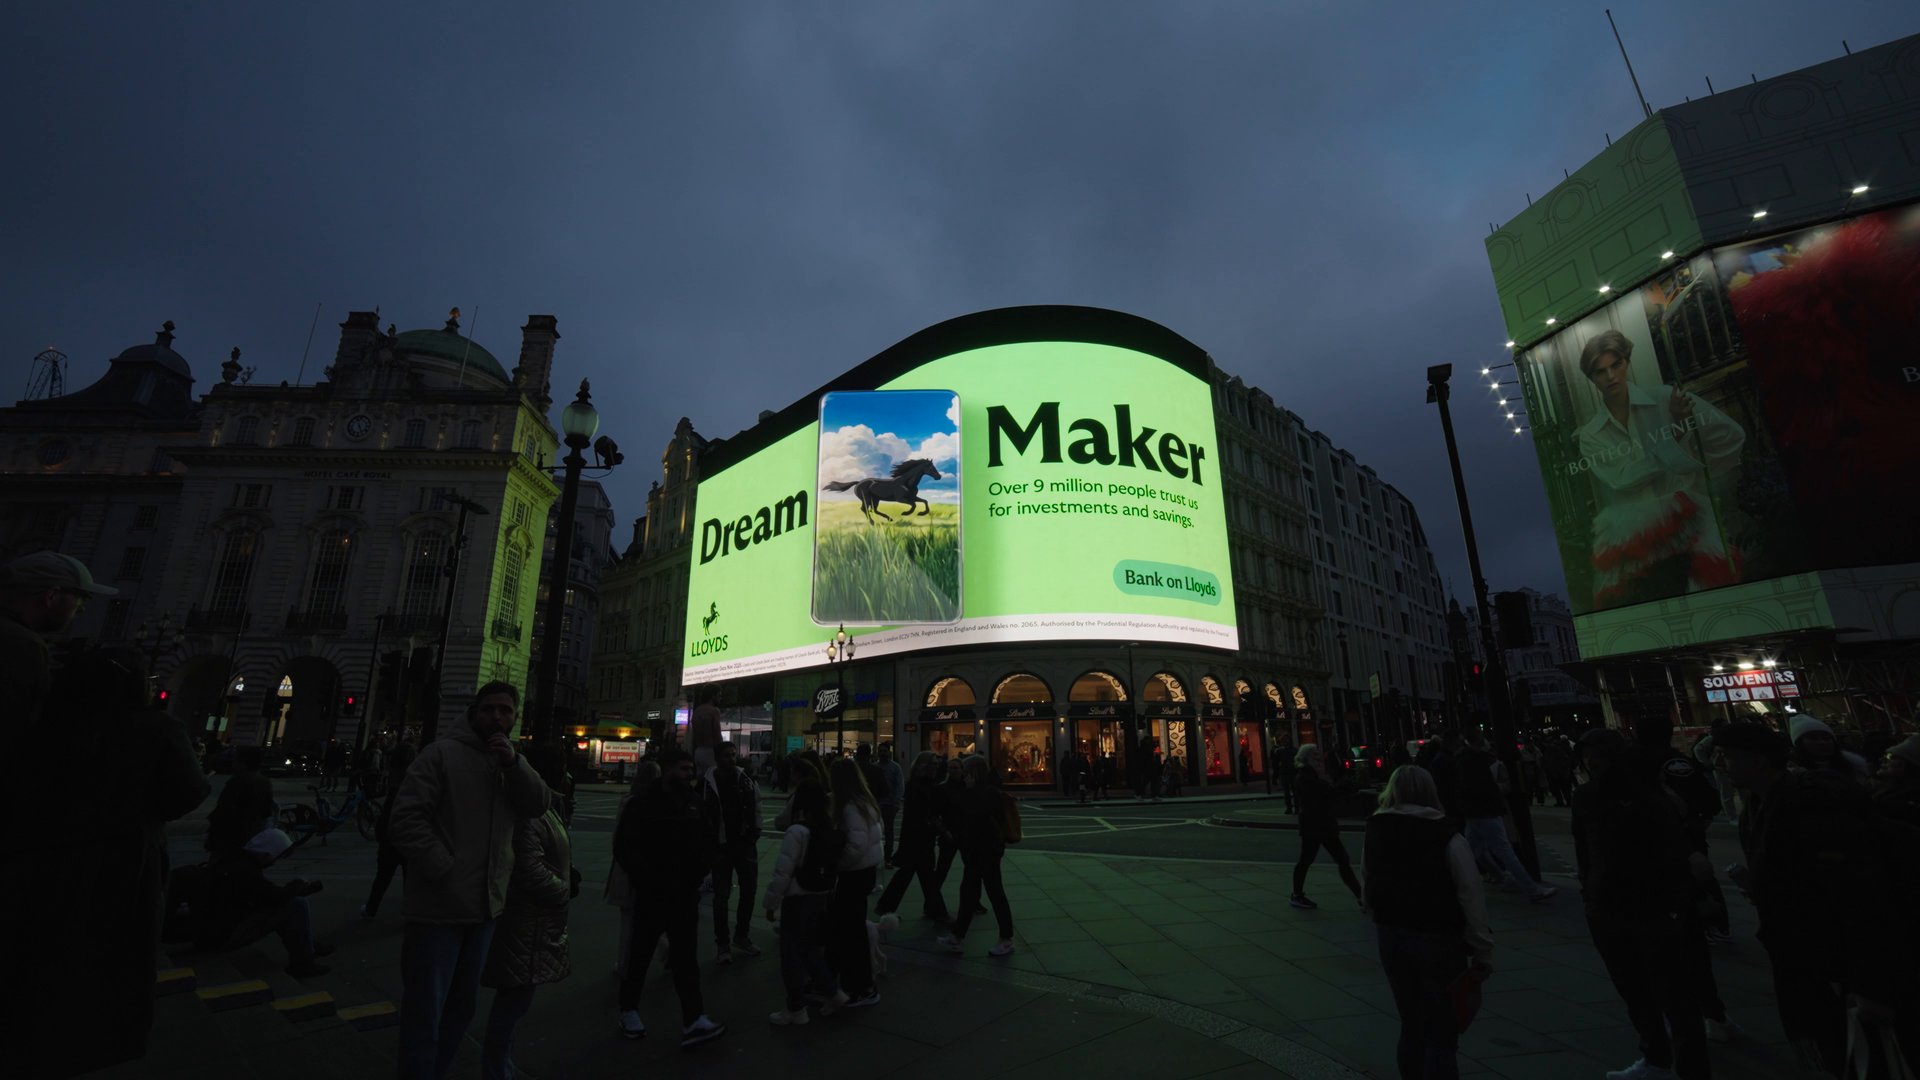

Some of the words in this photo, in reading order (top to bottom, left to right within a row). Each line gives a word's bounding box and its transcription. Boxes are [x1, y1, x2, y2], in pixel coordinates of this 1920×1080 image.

[986, 401, 1206, 487] Maker
[1568, 439, 1644, 476] BOTTEGA
[1646, 408, 1723, 445] VENETA
[363, 471, 392, 479] ROYAL
[988, 482, 1028, 496] Over
[1033, 479, 1044, 493] 9
[1050, 478, 1103, 493] million
[1108, 482, 1157, 499] people
[1160, 490, 1186, 505] trust
[1188, 499, 1199, 510] us
[699, 490, 808, 566] Dream
[988, 503, 1011, 517] for
[1017, 501, 1118, 515] investments
[1122, 504, 1149, 518] and
[1153, 508, 1195, 529] savings.
[1125, 569, 1164, 588] Bank
[1166, 578, 1183, 590] on
[1185, 576, 1217, 597] Lloyds
[921, 628, 947, 637] Registered
[954, 625, 976, 633] England
[1076, 620, 1083, 628] by
[1128, 620, 1157, 628] Regulation
[1157, 622, 1179, 631] Authority
[691, 635, 728, 657] LLOYDS
[1703, 670, 1795, 689] SOUVENIRS
[814, 688, 840, 713] Boots
